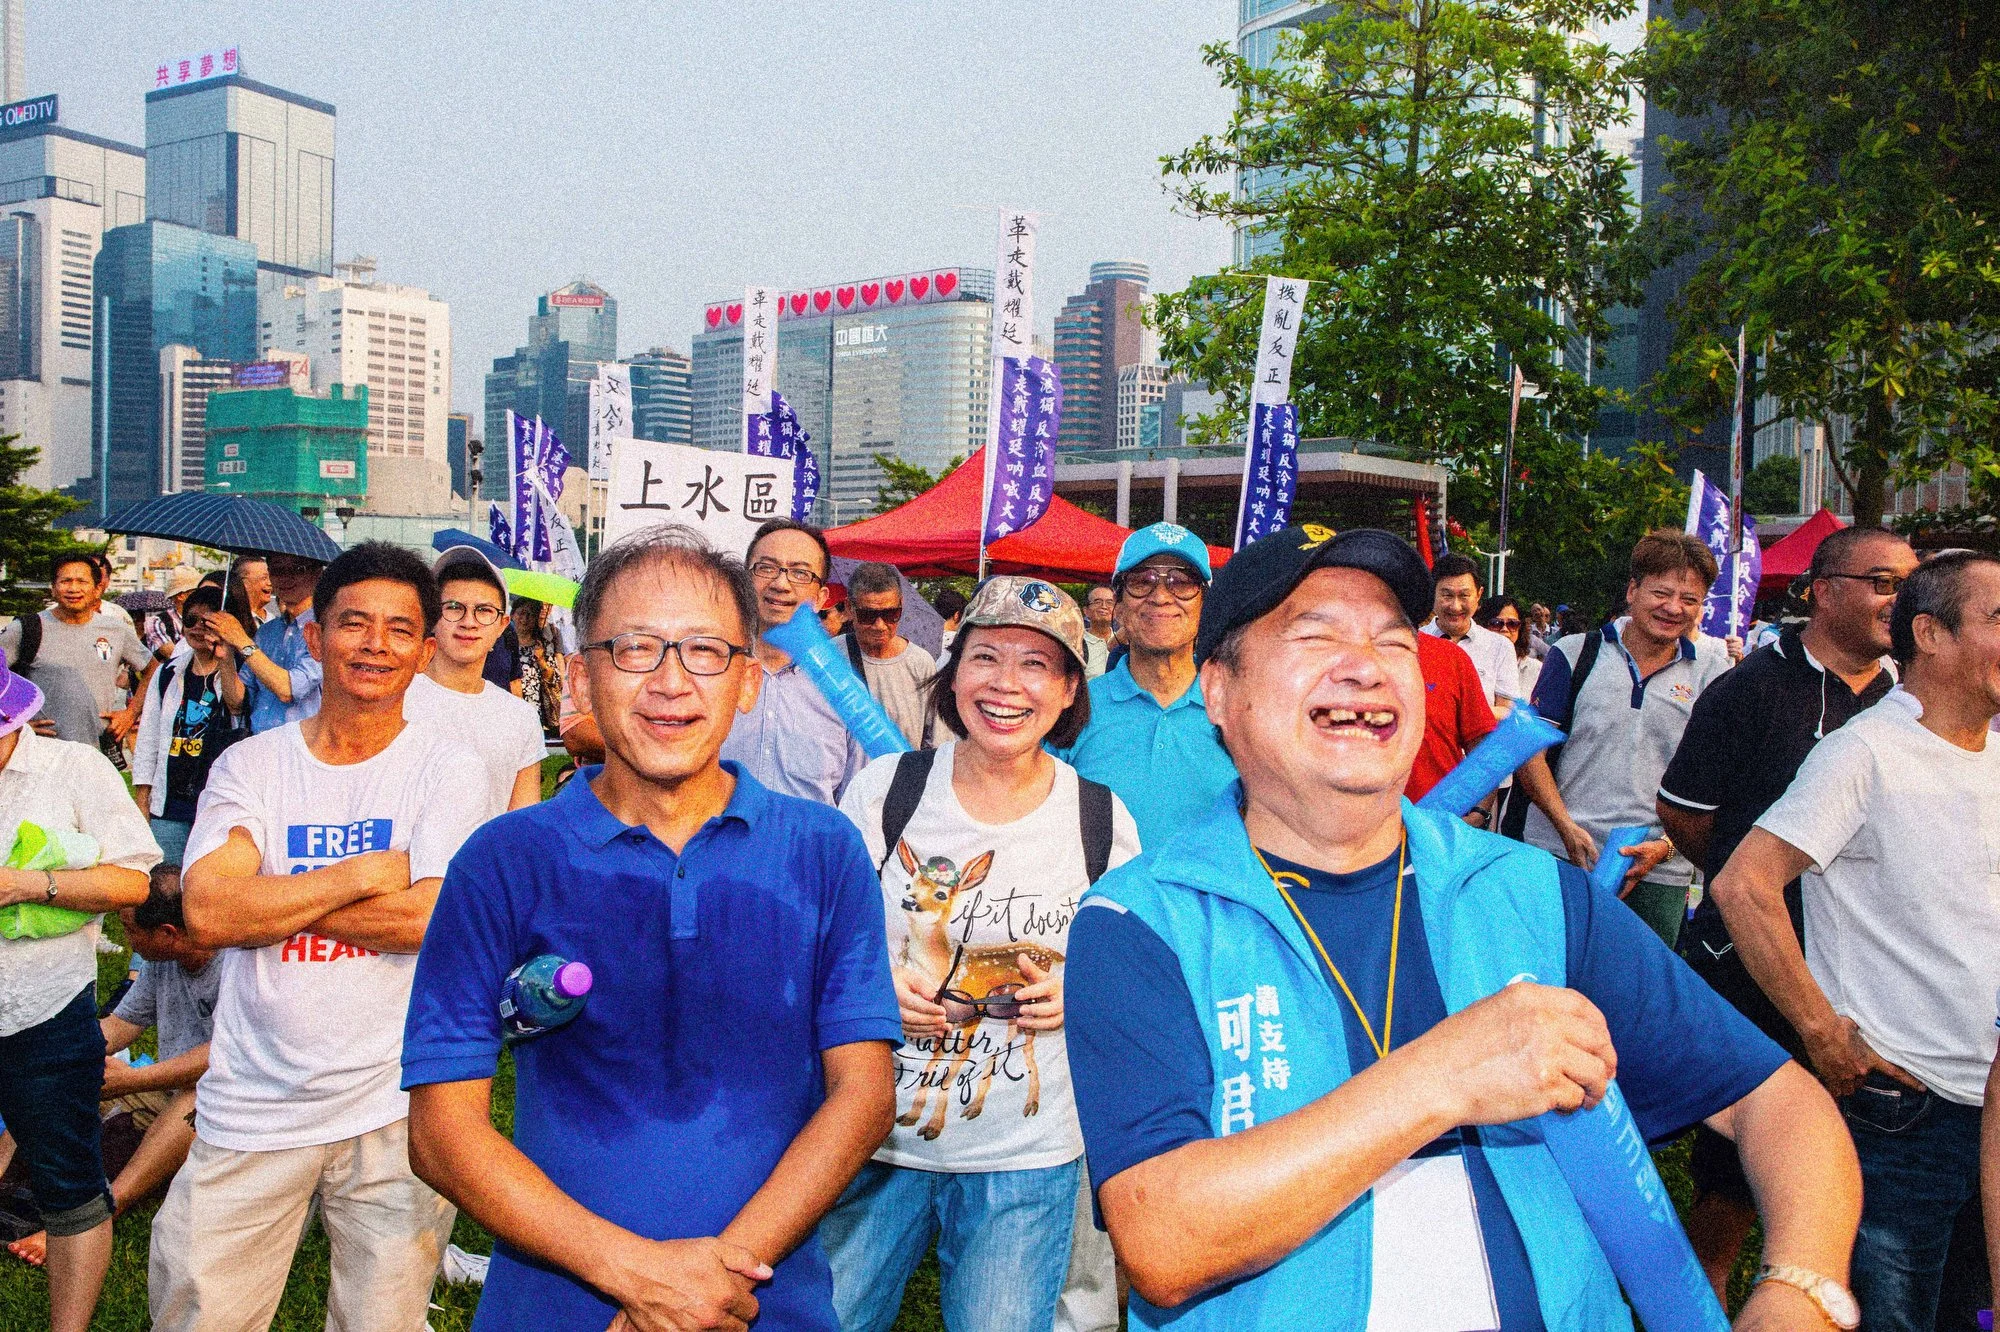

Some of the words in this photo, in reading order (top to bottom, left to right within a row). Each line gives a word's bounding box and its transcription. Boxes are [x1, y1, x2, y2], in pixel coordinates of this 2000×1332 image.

[156, 48, 237, 87] 共享夢想
[6, 104, 37, 125] OLED
[38, 100, 54, 118] TV
[619, 459, 779, 522] 上水區
[306, 820, 374, 857] FREE
[950, 889, 992, 943] if
[987, 887, 1042, 942] it
[904, 1030, 1000, 1054] atter,
[1256, 983, 1292, 1091] 請支持
[904, 1064, 950, 1091] rid
[957, 1065, 982, 1105] of
